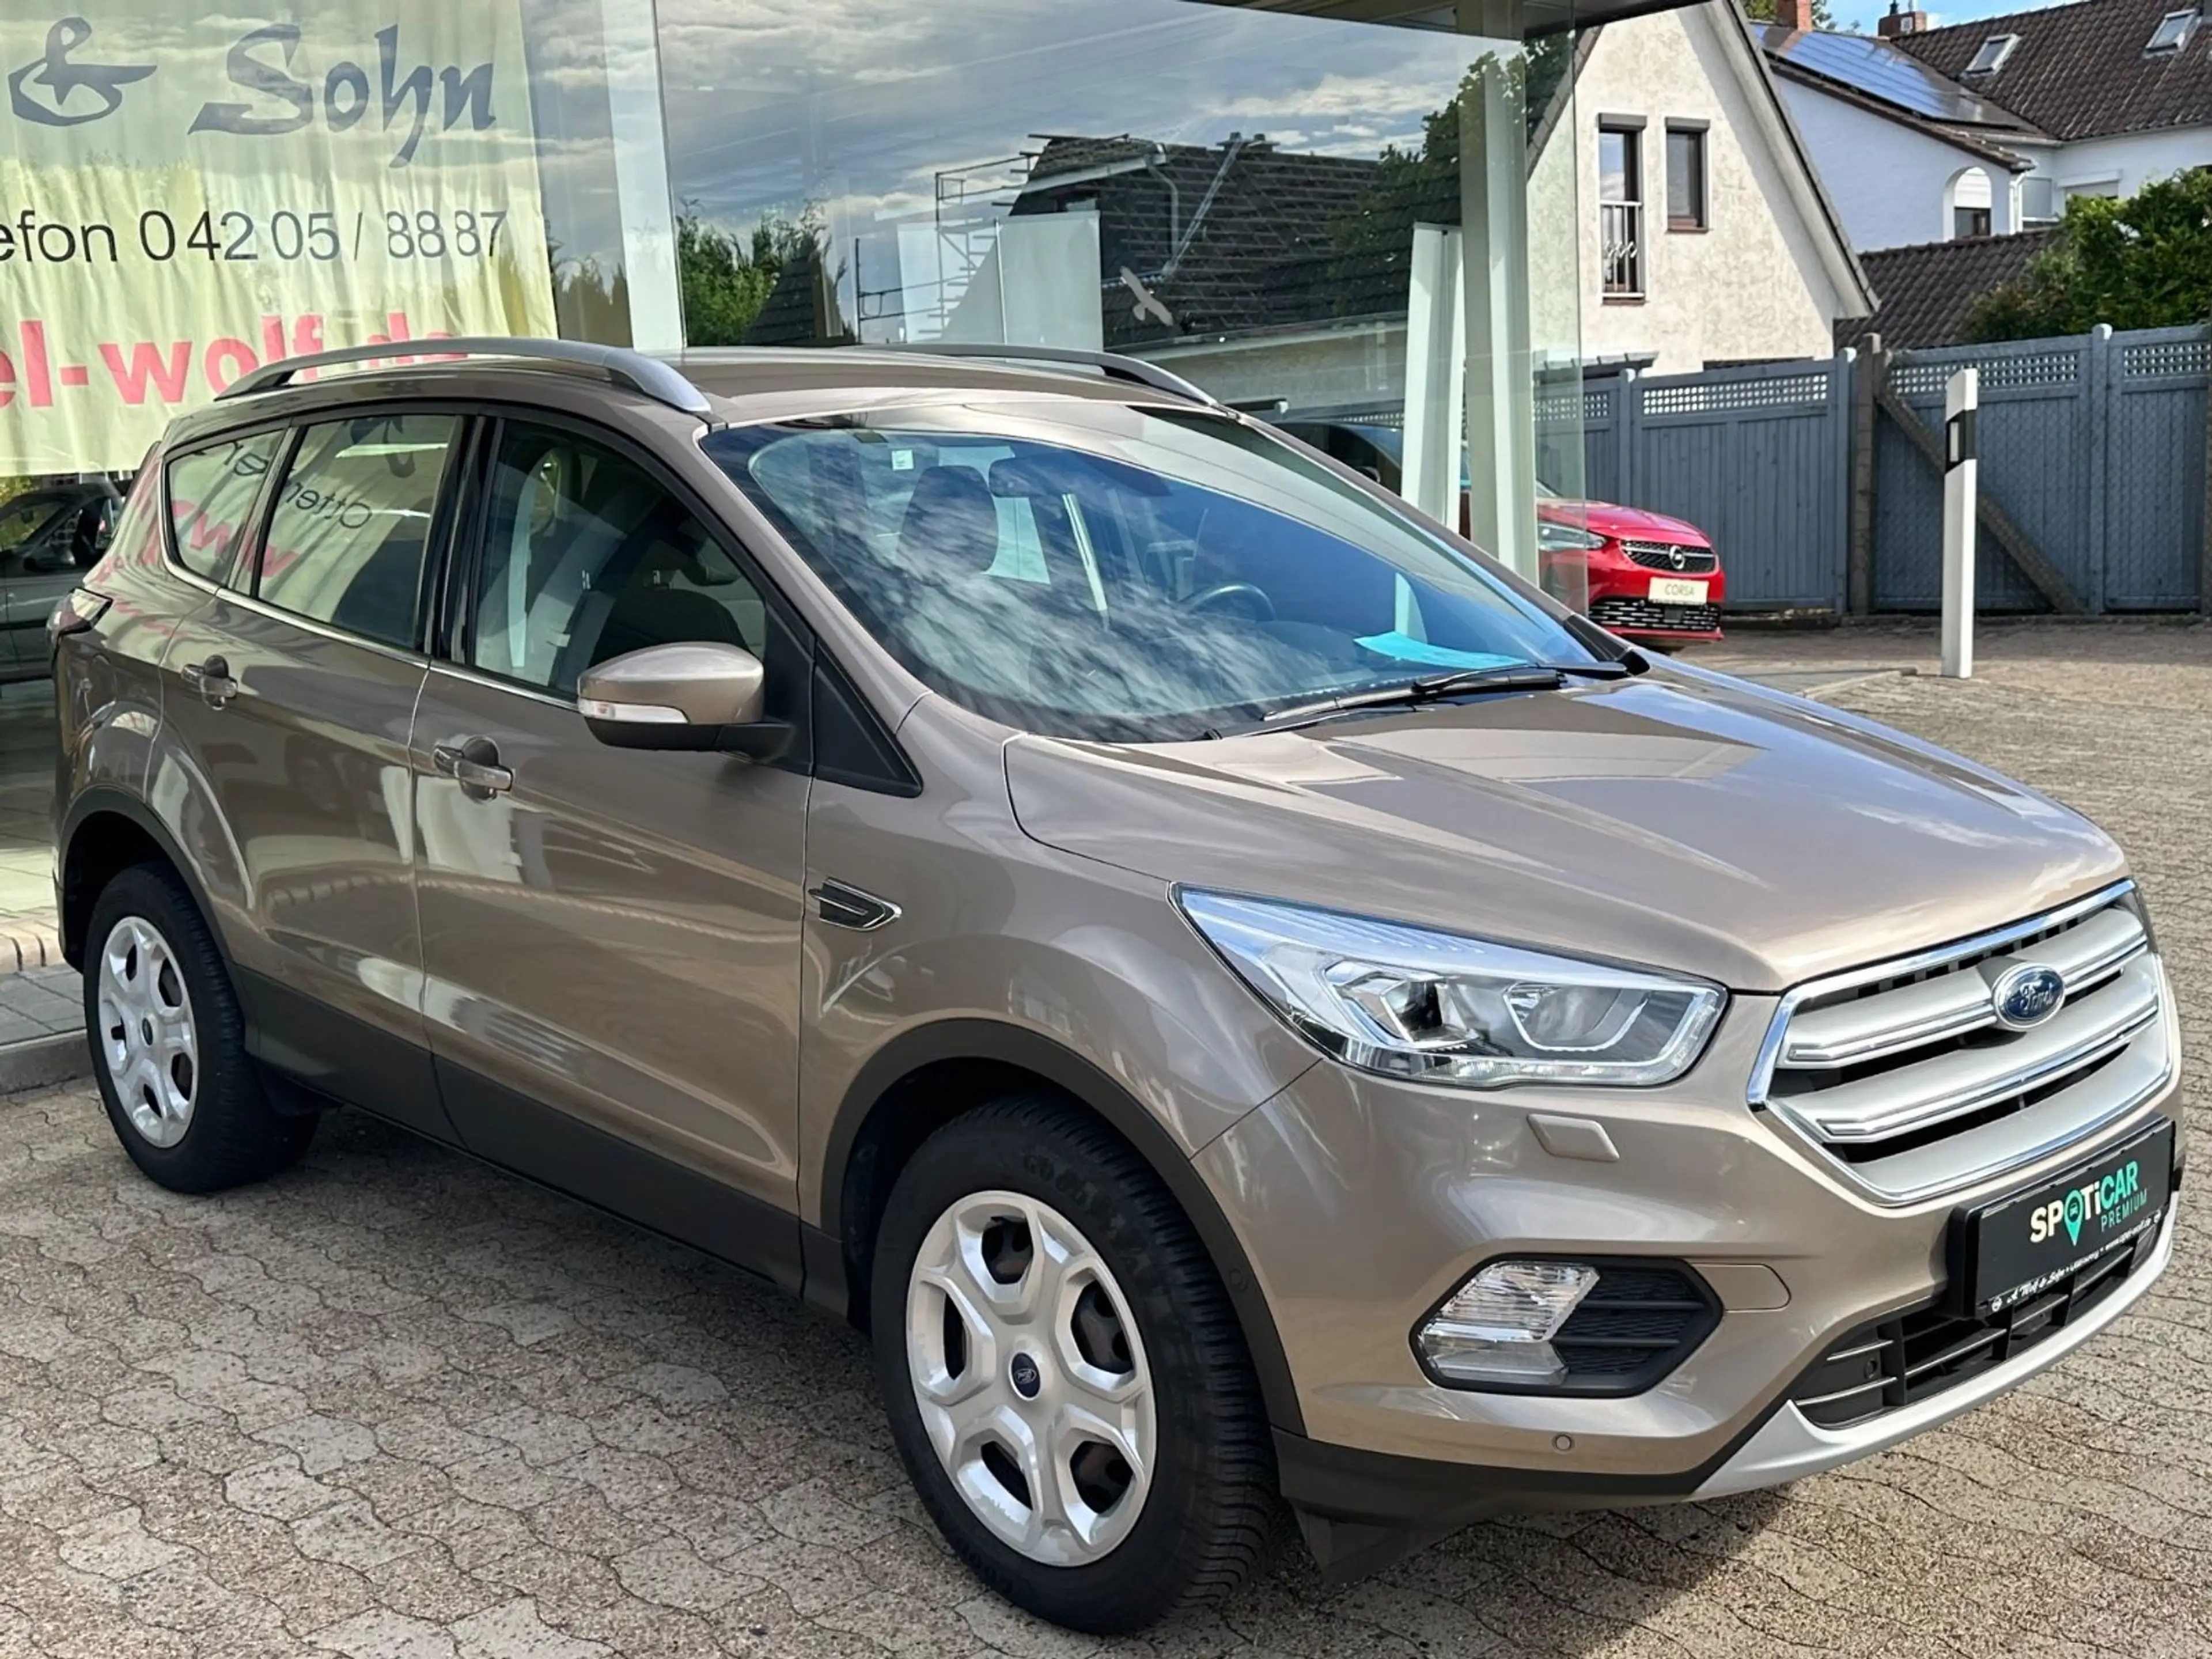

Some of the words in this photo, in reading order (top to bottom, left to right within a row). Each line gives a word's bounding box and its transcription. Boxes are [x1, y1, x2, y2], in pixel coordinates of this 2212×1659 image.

[8, 17, 157, 126] &
[188, 24, 496, 168] Sohn
[2101, 1188, 2147, 1232] PREMIUM
